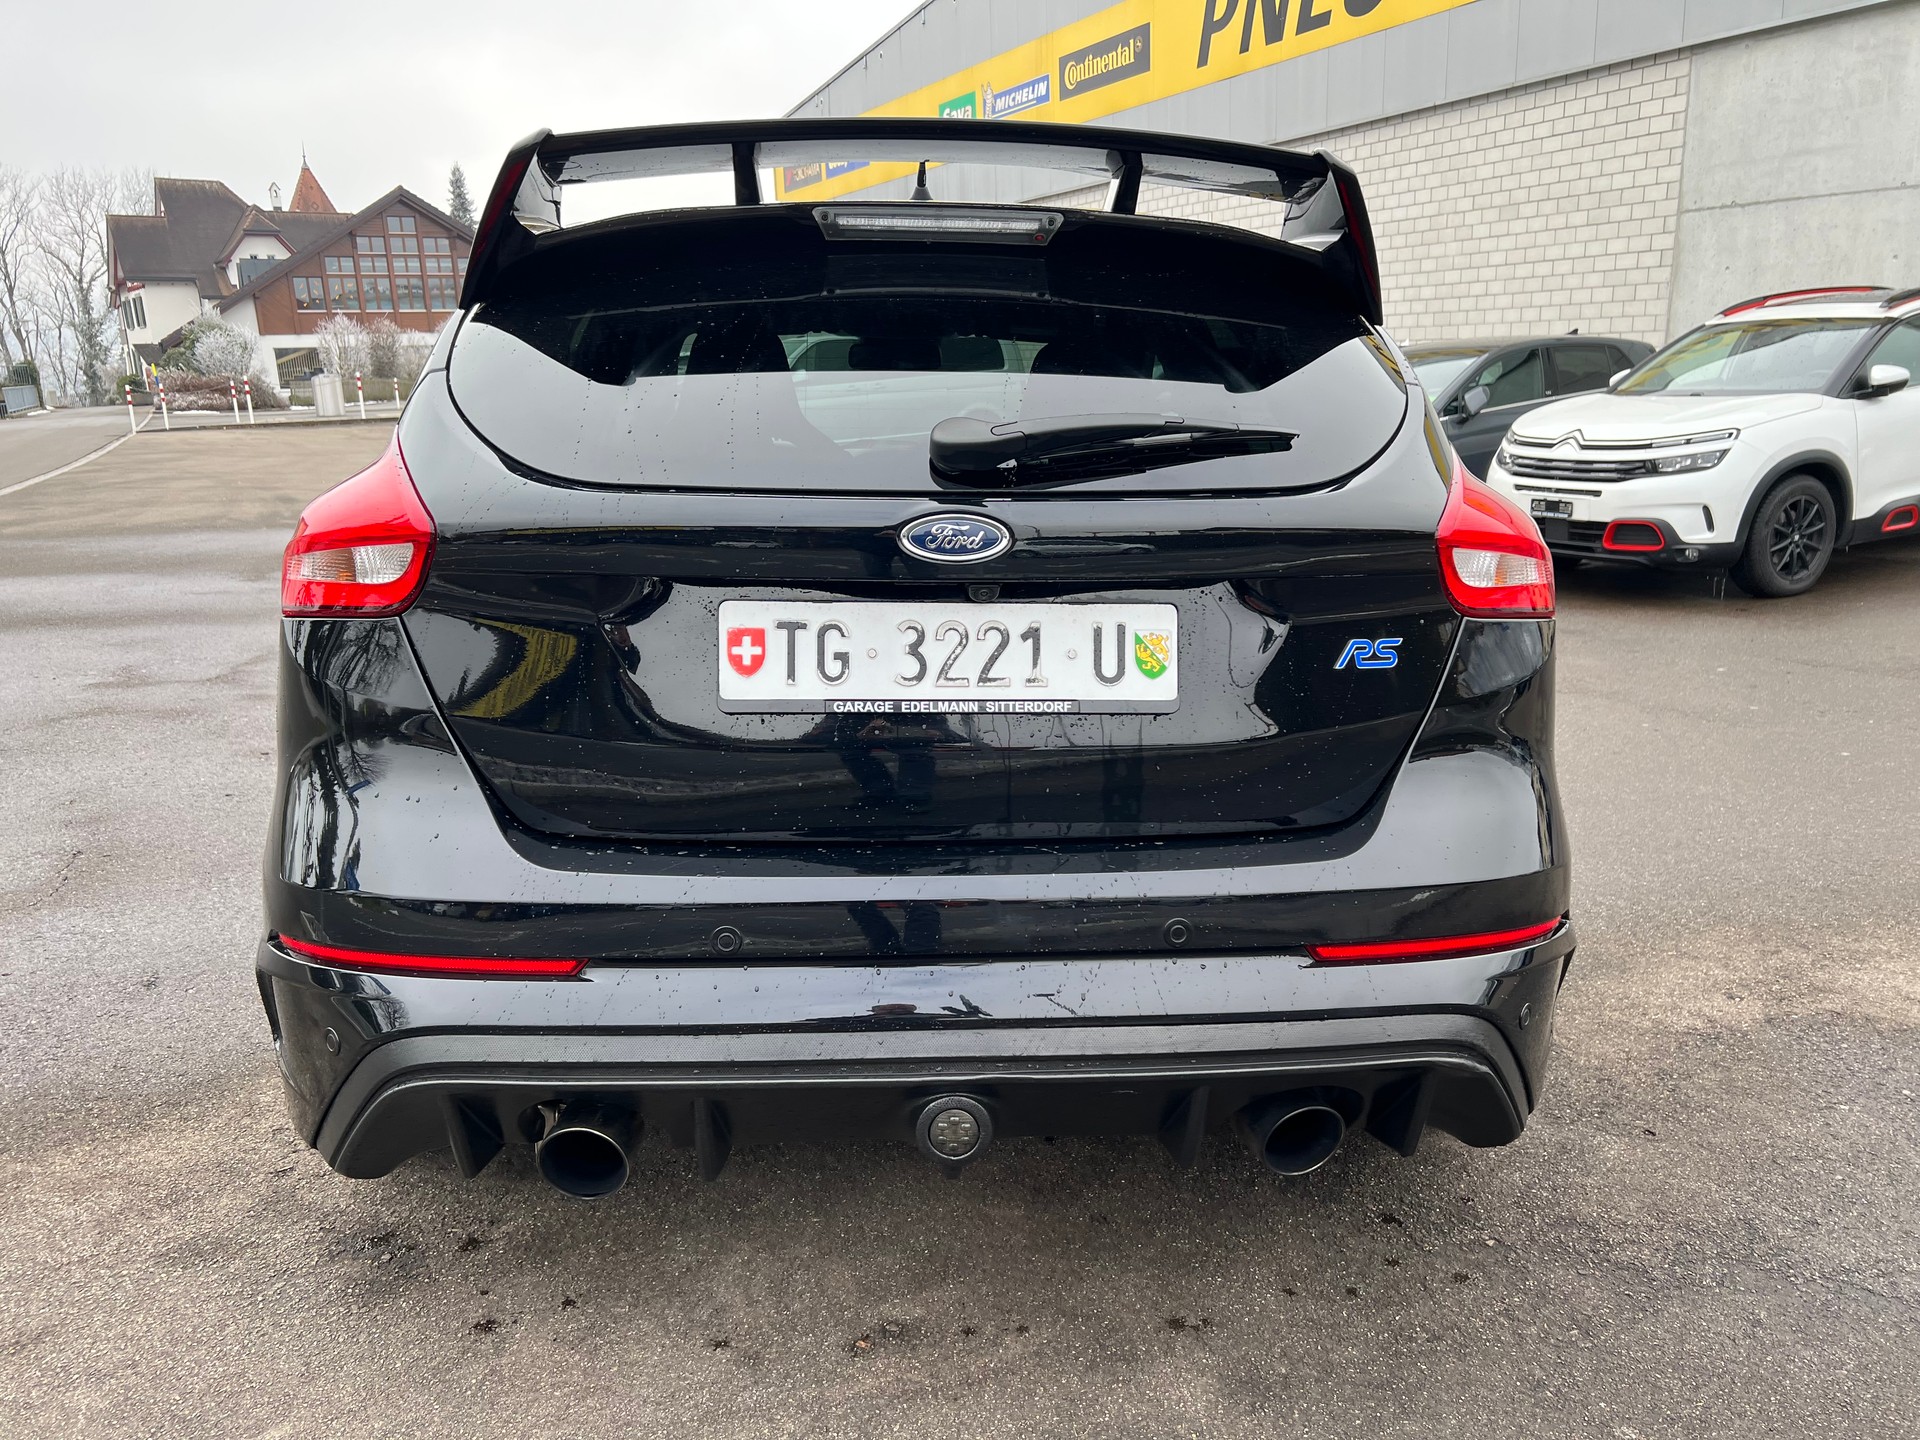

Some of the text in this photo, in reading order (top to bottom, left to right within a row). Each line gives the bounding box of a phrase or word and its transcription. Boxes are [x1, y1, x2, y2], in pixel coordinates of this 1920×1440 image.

[1064, 38, 1135, 90] Continental
[995, 81, 1048, 112] MICHELIN
[925, 523, 985, 549] Ford
[774, 620, 1127, 688] TG 3221 U
[1333, 637, 1403, 669] RS
[833, 701, 1072, 713] GARAGE EDELMANN SITTERDORF
